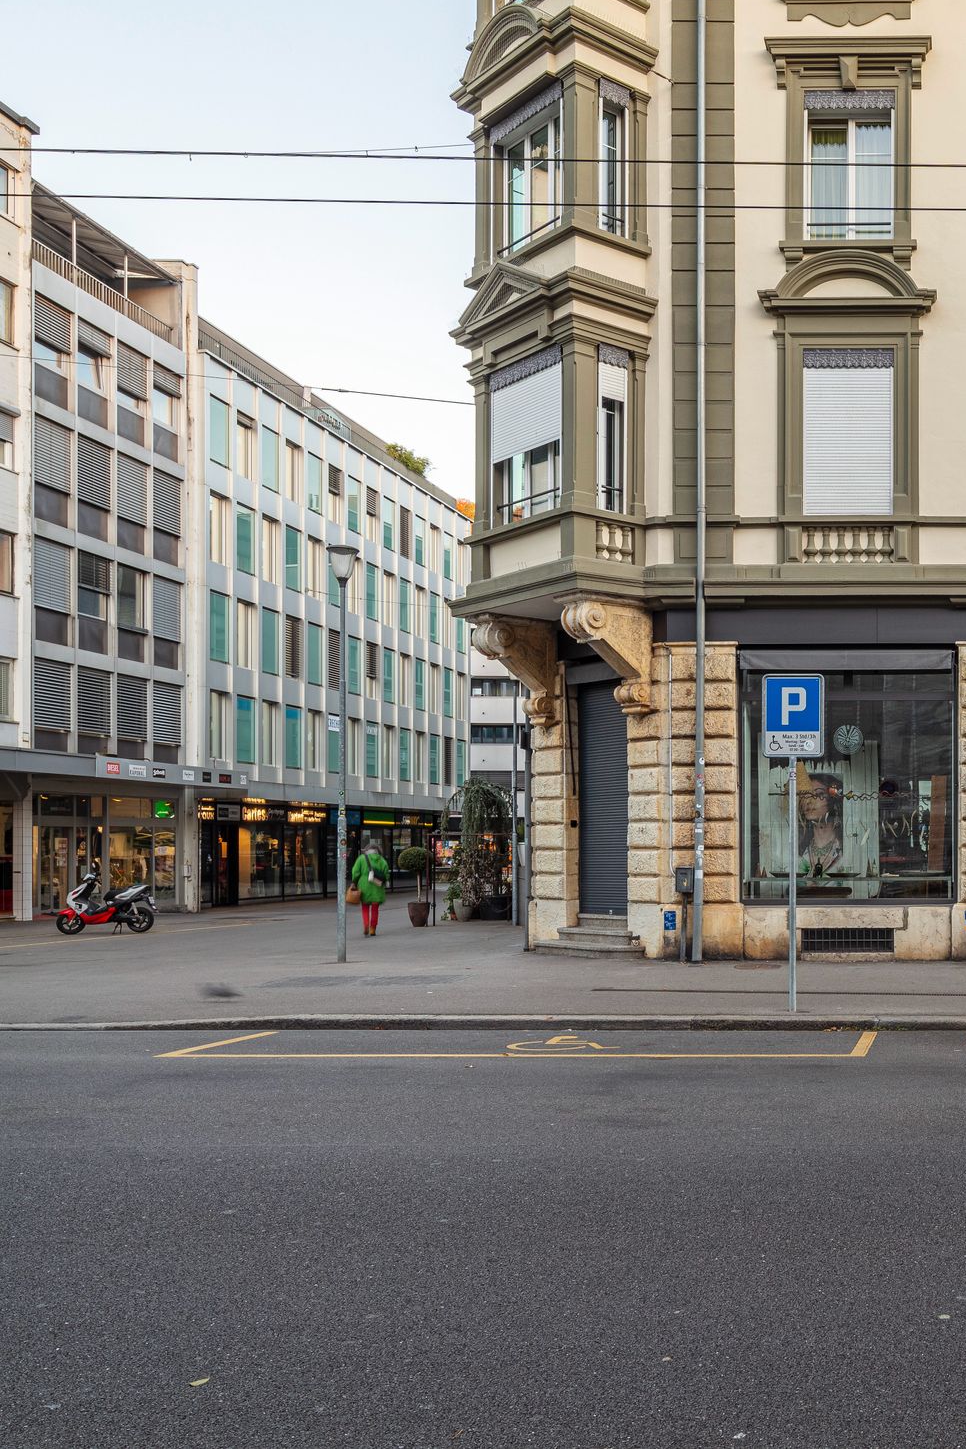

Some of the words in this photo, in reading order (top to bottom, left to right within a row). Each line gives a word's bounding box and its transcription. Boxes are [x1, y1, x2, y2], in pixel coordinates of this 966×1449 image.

[781, 686, 807, 726] P
[107, 763, 119, 772] DIESEL
[242, 806, 266, 821] Cartes
